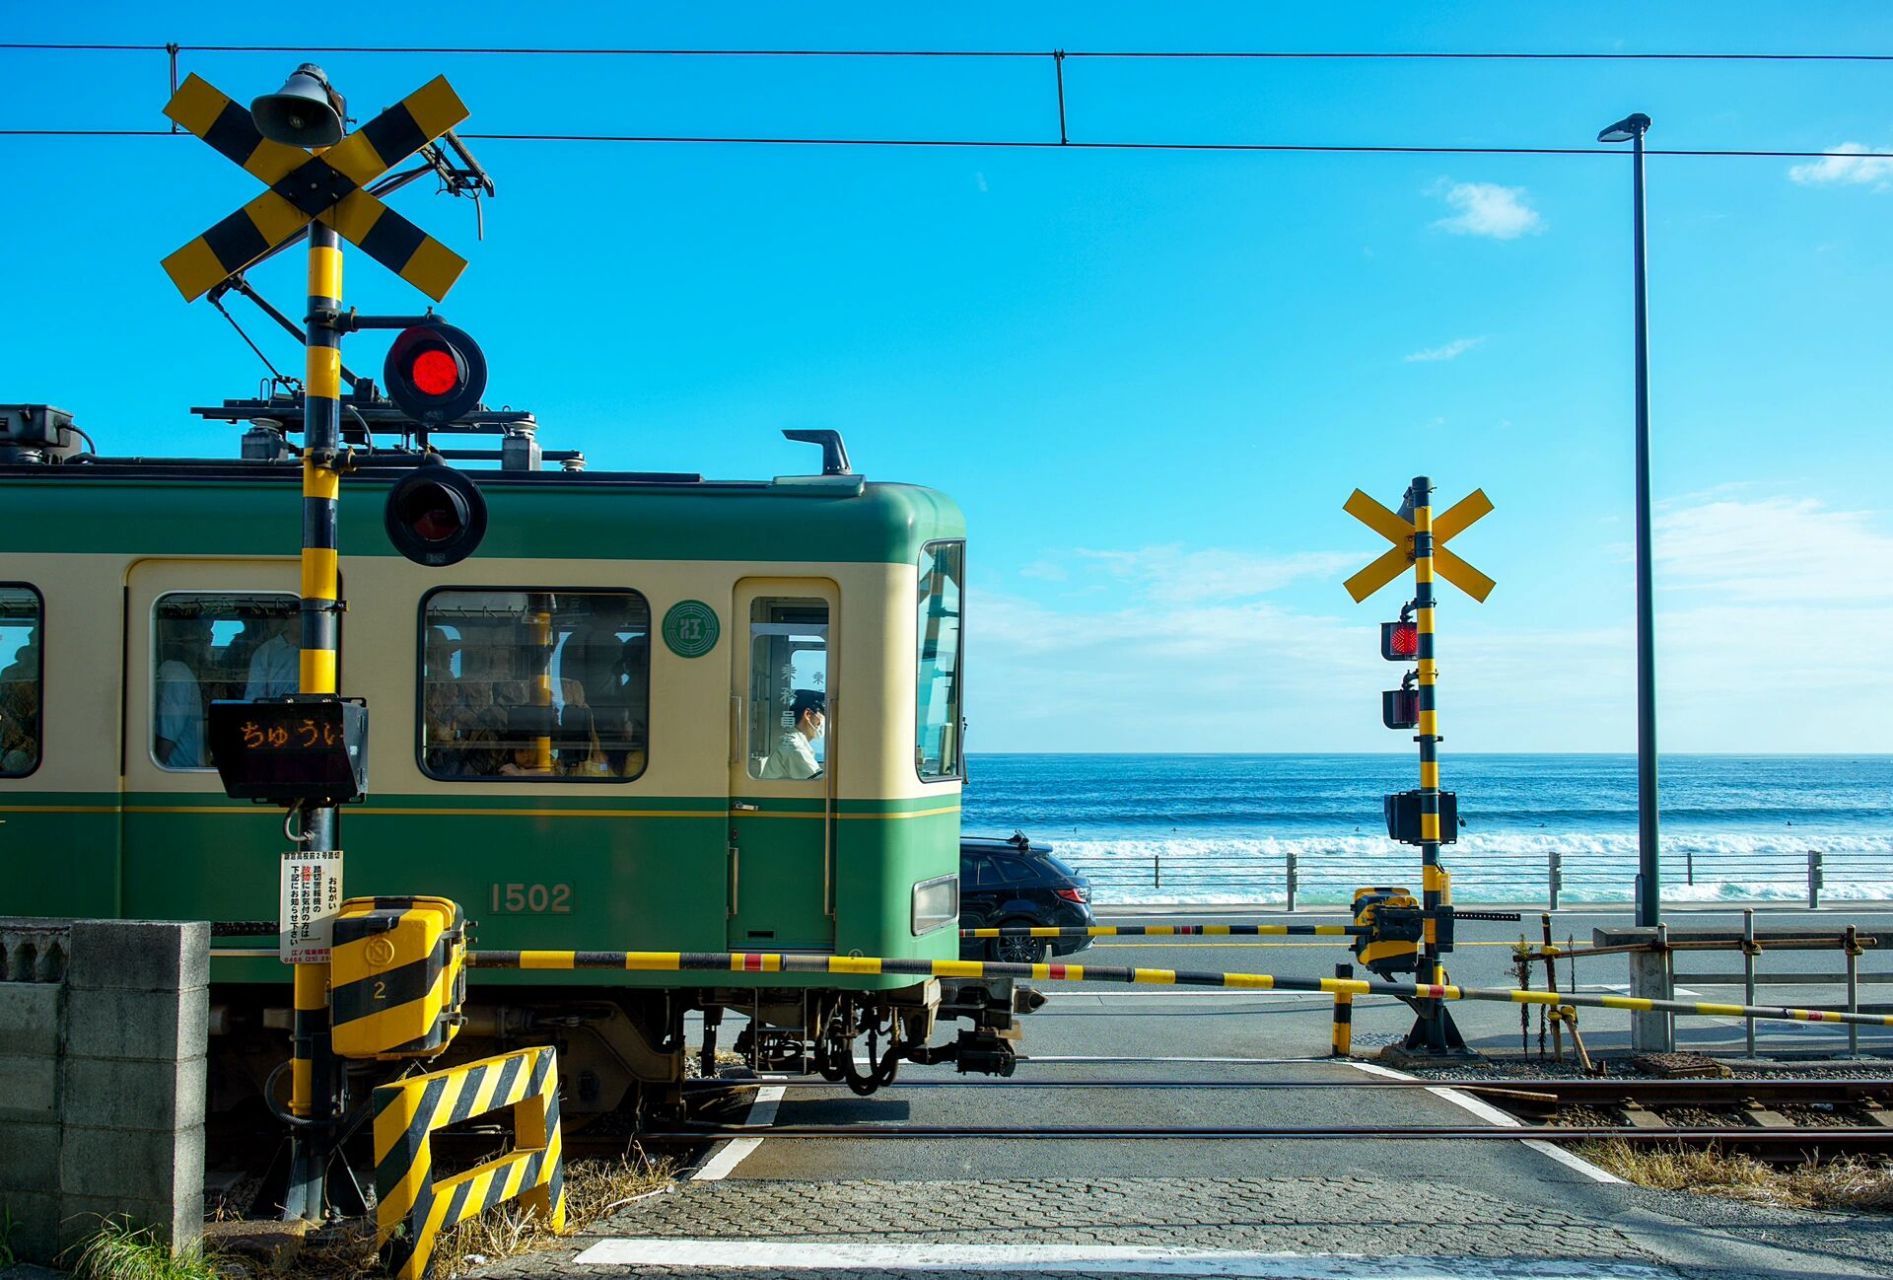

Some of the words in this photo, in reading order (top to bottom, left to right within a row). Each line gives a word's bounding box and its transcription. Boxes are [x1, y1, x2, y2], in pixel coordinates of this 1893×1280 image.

[240, 719, 344, 748] ちゅうい
[290, 865, 300, 946] 下記にお知らせ下さい
[301, 865, 311, 938] 故障にお気付の方は
[313, 865, 322, 913] 踏切警報機の
[328, 877, 338, 910] おねがい
[492, 883, 571, 912] 1502
[374, 981, 386, 999] 2
